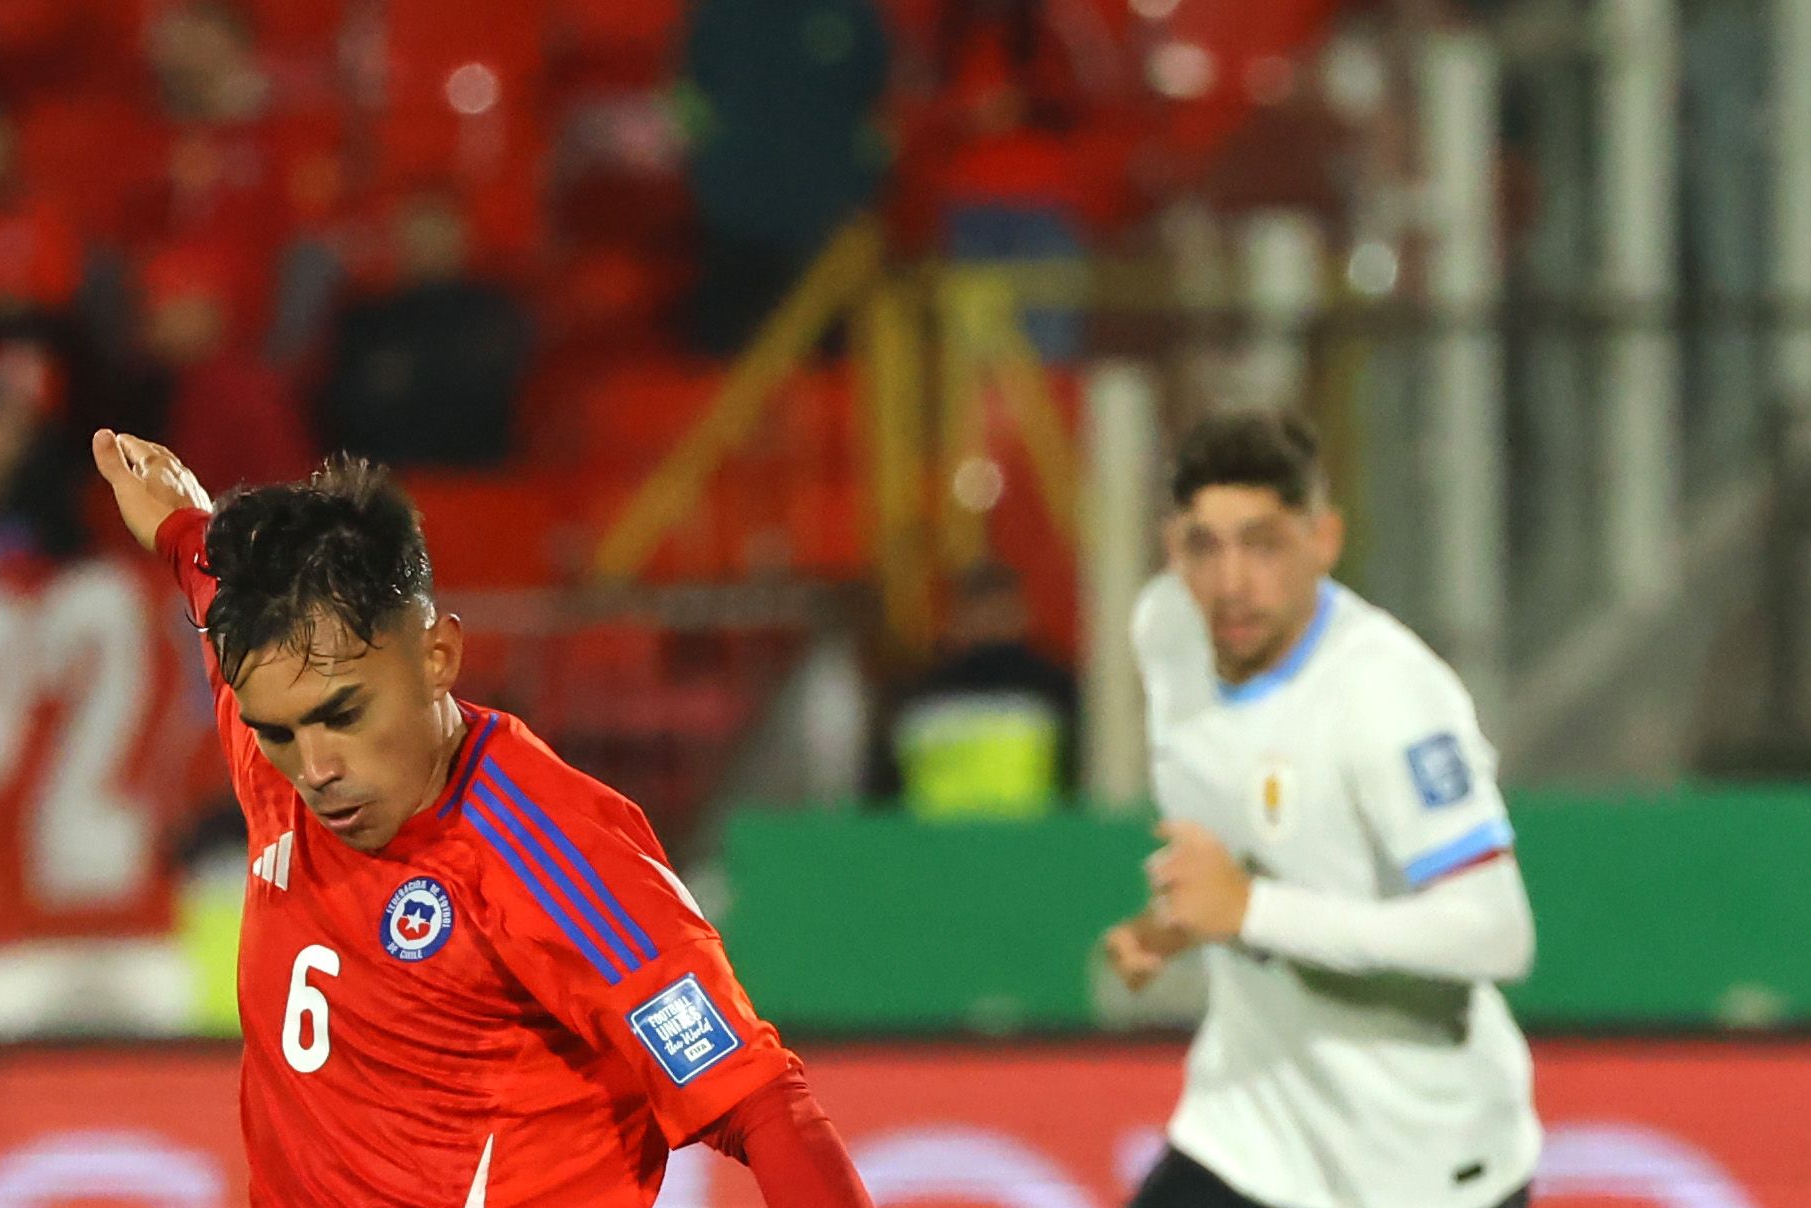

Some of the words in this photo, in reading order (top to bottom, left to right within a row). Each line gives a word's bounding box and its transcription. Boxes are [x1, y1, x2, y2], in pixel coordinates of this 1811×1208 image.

[282, 944, 340, 1073] 6
[647, 995, 692, 1028] FOOTBALL
[689, 1044, 708, 1057] FIFA
